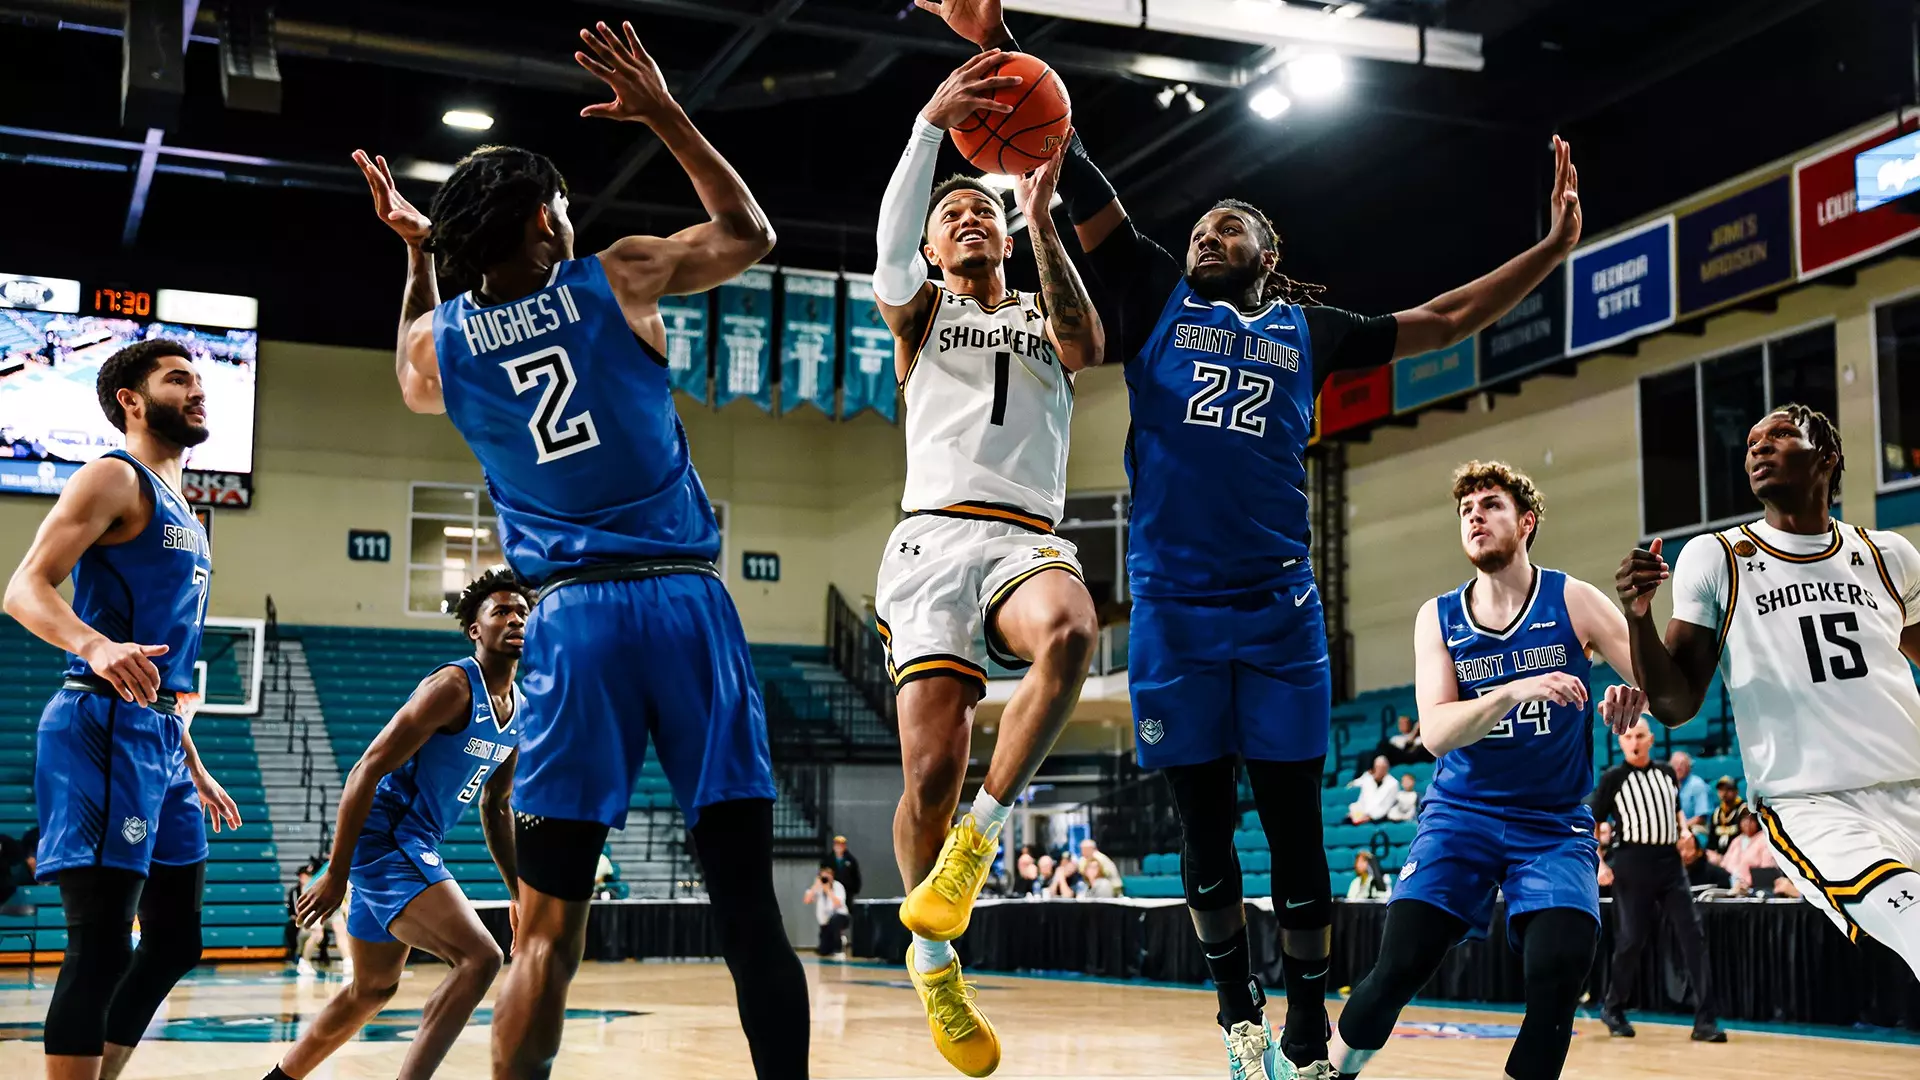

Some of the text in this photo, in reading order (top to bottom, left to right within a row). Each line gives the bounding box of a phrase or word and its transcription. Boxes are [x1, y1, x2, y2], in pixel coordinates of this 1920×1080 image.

[95, 289, 150, 315] 17:30
[462, 284, 580, 356] HUGHES II
[940, 325, 1053, 366] SHOCKERS
[1174, 323, 1299, 373] SAINT LOUIS
[498, 345, 600, 465] 2
[990, 352, 1010, 426] 1
[1183, 360, 1274, 437] 22
[354, 536, 386, 558] 111
[748, 557, 776, 577] 111
[192, 564, 208, 628] 7
[1755, 582, 1878, 616] SHOCKERS
[1455, 644, 1567, 682] SAINT LOUIS
[1798, 612, 1869, 683] 15
[457, 765, 490, 804] 5
